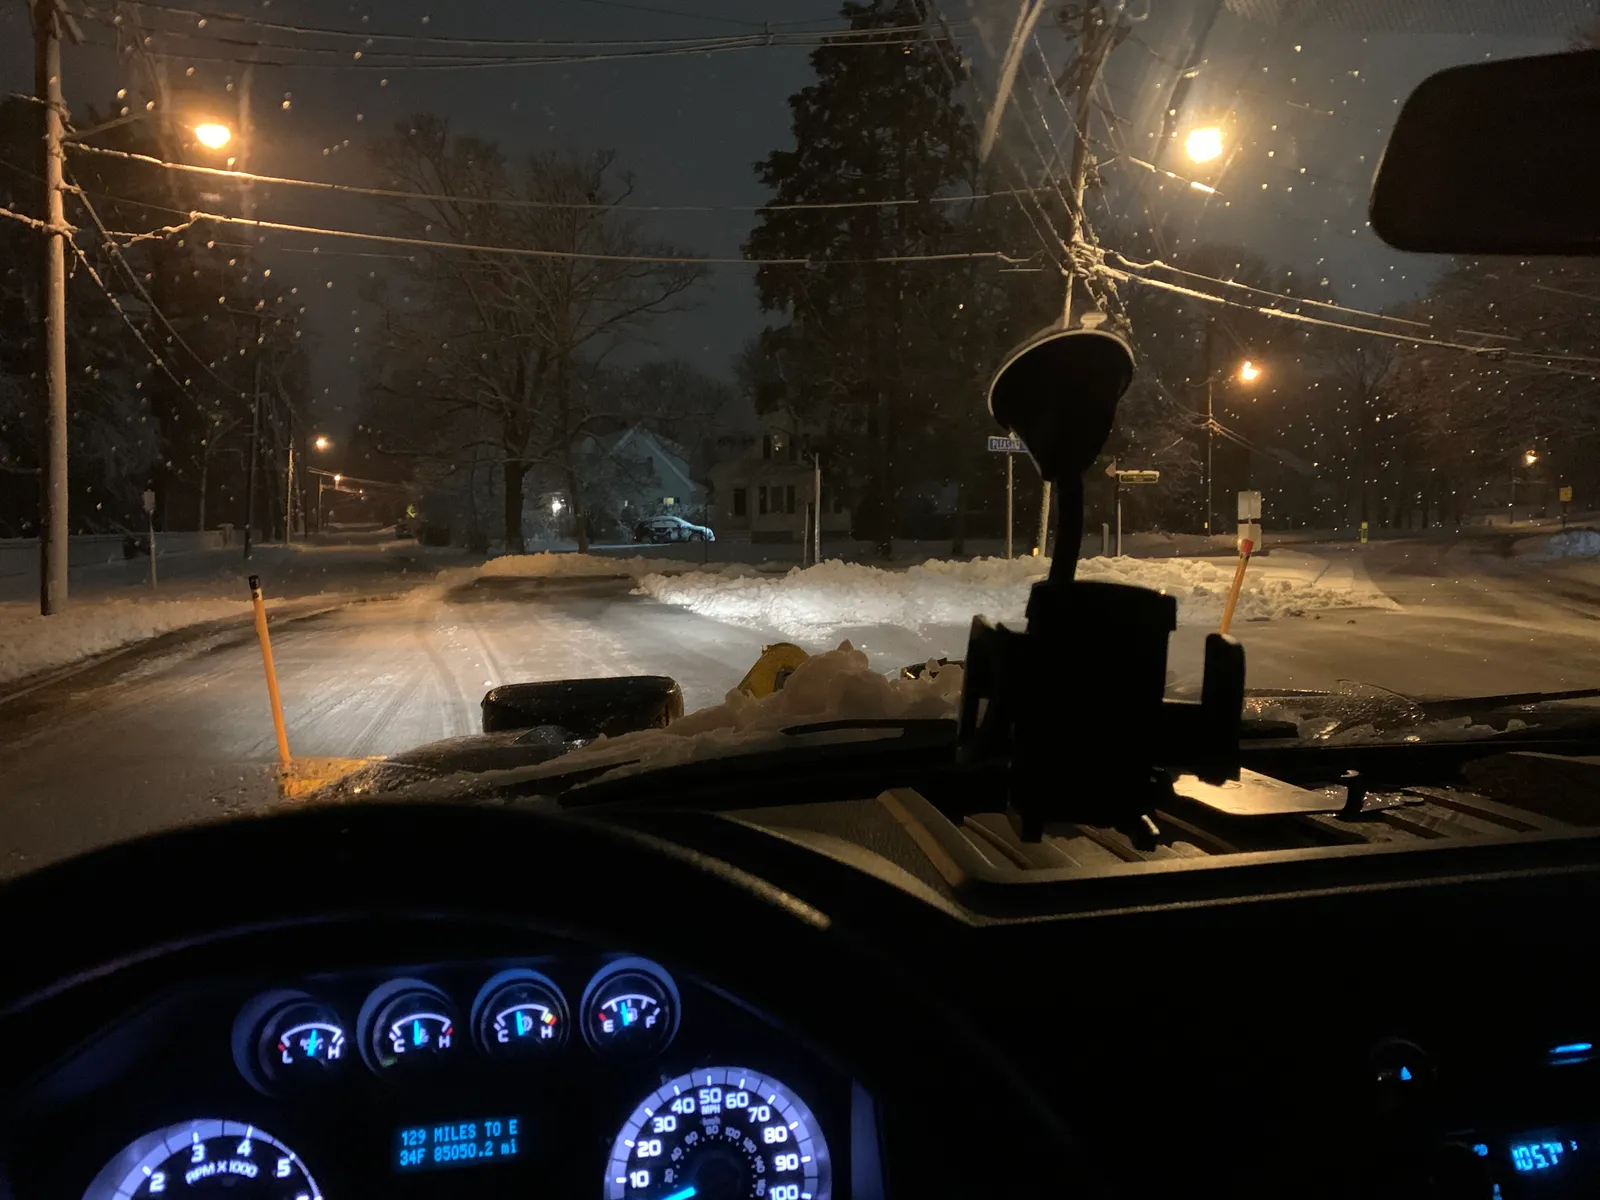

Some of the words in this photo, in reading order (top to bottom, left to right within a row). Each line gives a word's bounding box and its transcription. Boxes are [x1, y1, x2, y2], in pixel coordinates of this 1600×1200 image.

[603, 1020, 614, 1033] E
[645, 1016, 656, 1028] F
[497, 1029, 509, 1042] C
[540, 1026, 552, 1039] H
[393, 1039, 405, 1053] C
[438, 1035, 451, 1048] H
[282, 1050, 293, 1064] L
[327, 1046, 340, 1059] H
[699, 1088, 722, 1105] 50
[725, 1092, 749, 1109] 60
[671, 1097, 695, 1114] 40
[701, 1104, 721, 1115] MPH
[748, 1106, 770, 1123] 70
[401, 1129, 426, 1146] 129
[433, 1123, 476, 1143] MILES
[484, 1121, 501, 1137] TO
[509, 1119, 518, 1135] E
[653, 1116, 677, 1133] 30
[764, 1126, 787, 1144] 80
[190, 1144, 205, 1163] 3
[236, 1138, 251, 1157] 4
[399, 1148, 426, 1166] 34F
[501, 1138, 517, 1155] mi
[637, 1140, 661, 1158] 20
[276, 1159, 291, 1178] 5
[774, 1154, 799, 1172] 90
[185, 1162, 215, 1185] RPM
[228, 1161, 259, 1178] 1000
[630, 1171, 649, 1188] 10
[149, 1172, 165, 1193] 2
[770, 1185, 799, 1200] 100
